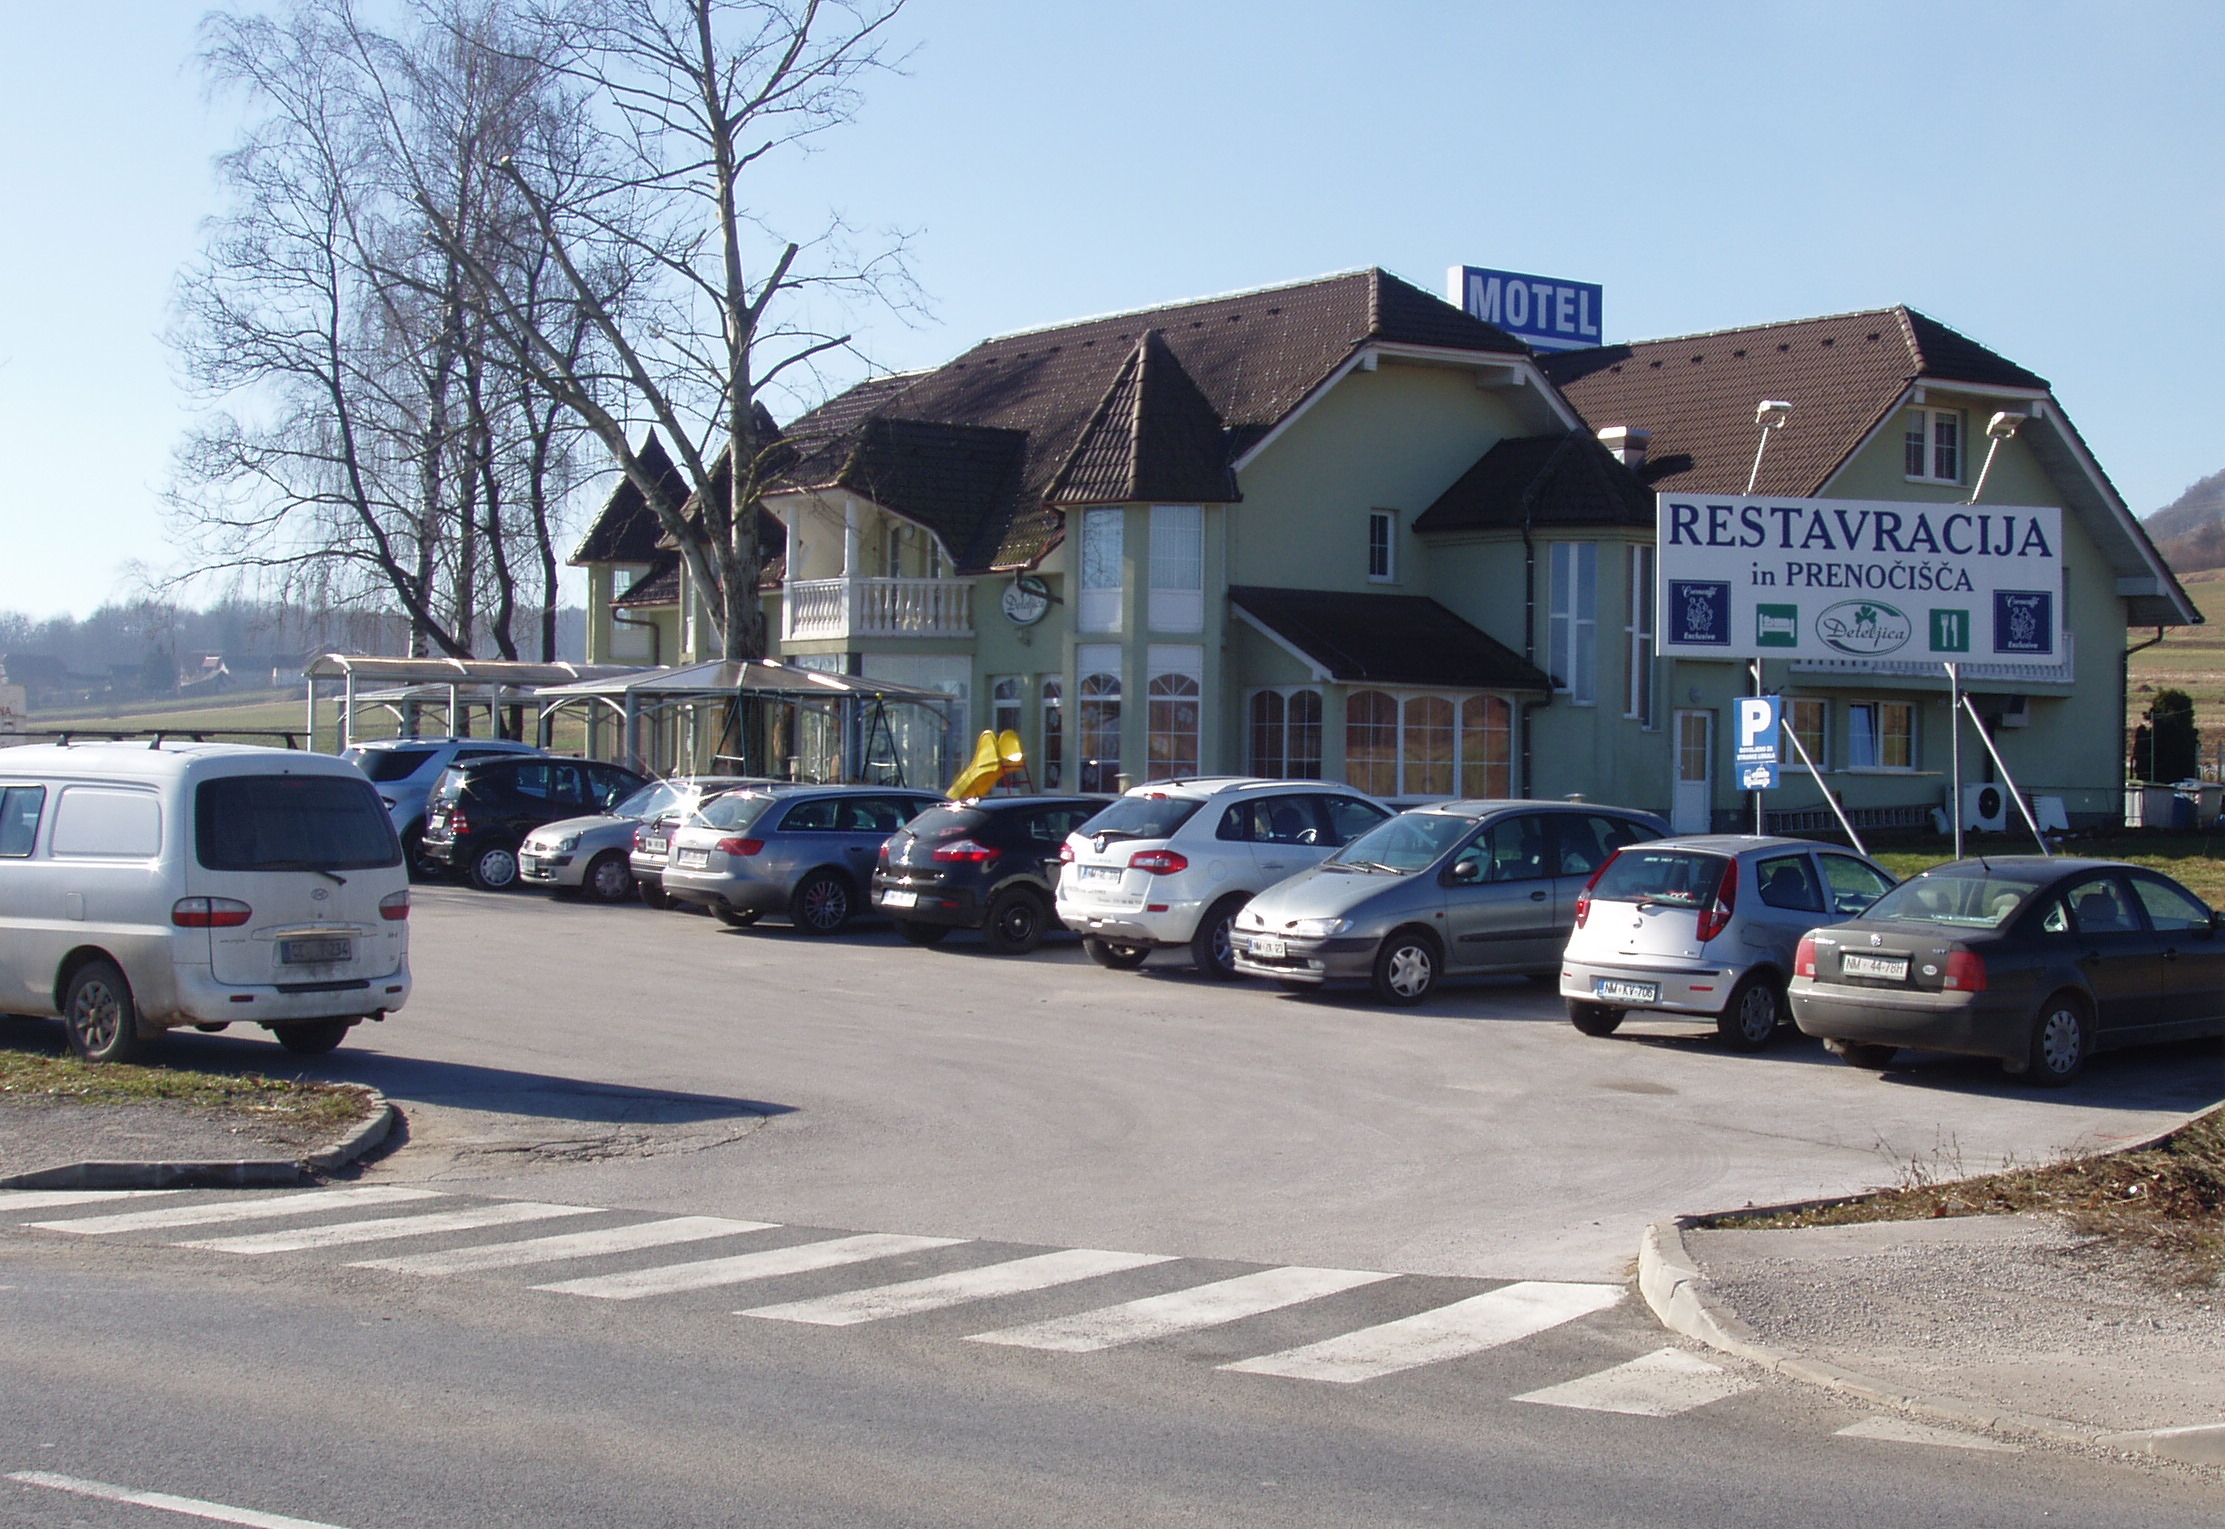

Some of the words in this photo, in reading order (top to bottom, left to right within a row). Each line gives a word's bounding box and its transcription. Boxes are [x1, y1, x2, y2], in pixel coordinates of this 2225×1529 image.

[1469, 275, 1597, 336] MOTEL
[1668, 503, 2053, 558] RESTAVRACIJA
[1751, 561, 1775, 586] in
[1786, 560, 1975, 592] PRENOČIŠČA
[1823, 618, 1905, 648] Deteljica
[1741, 699, 1772, 747] P
[1846, 957, 1861, 971] NM
[1604, 981, 1618, 994] NM
